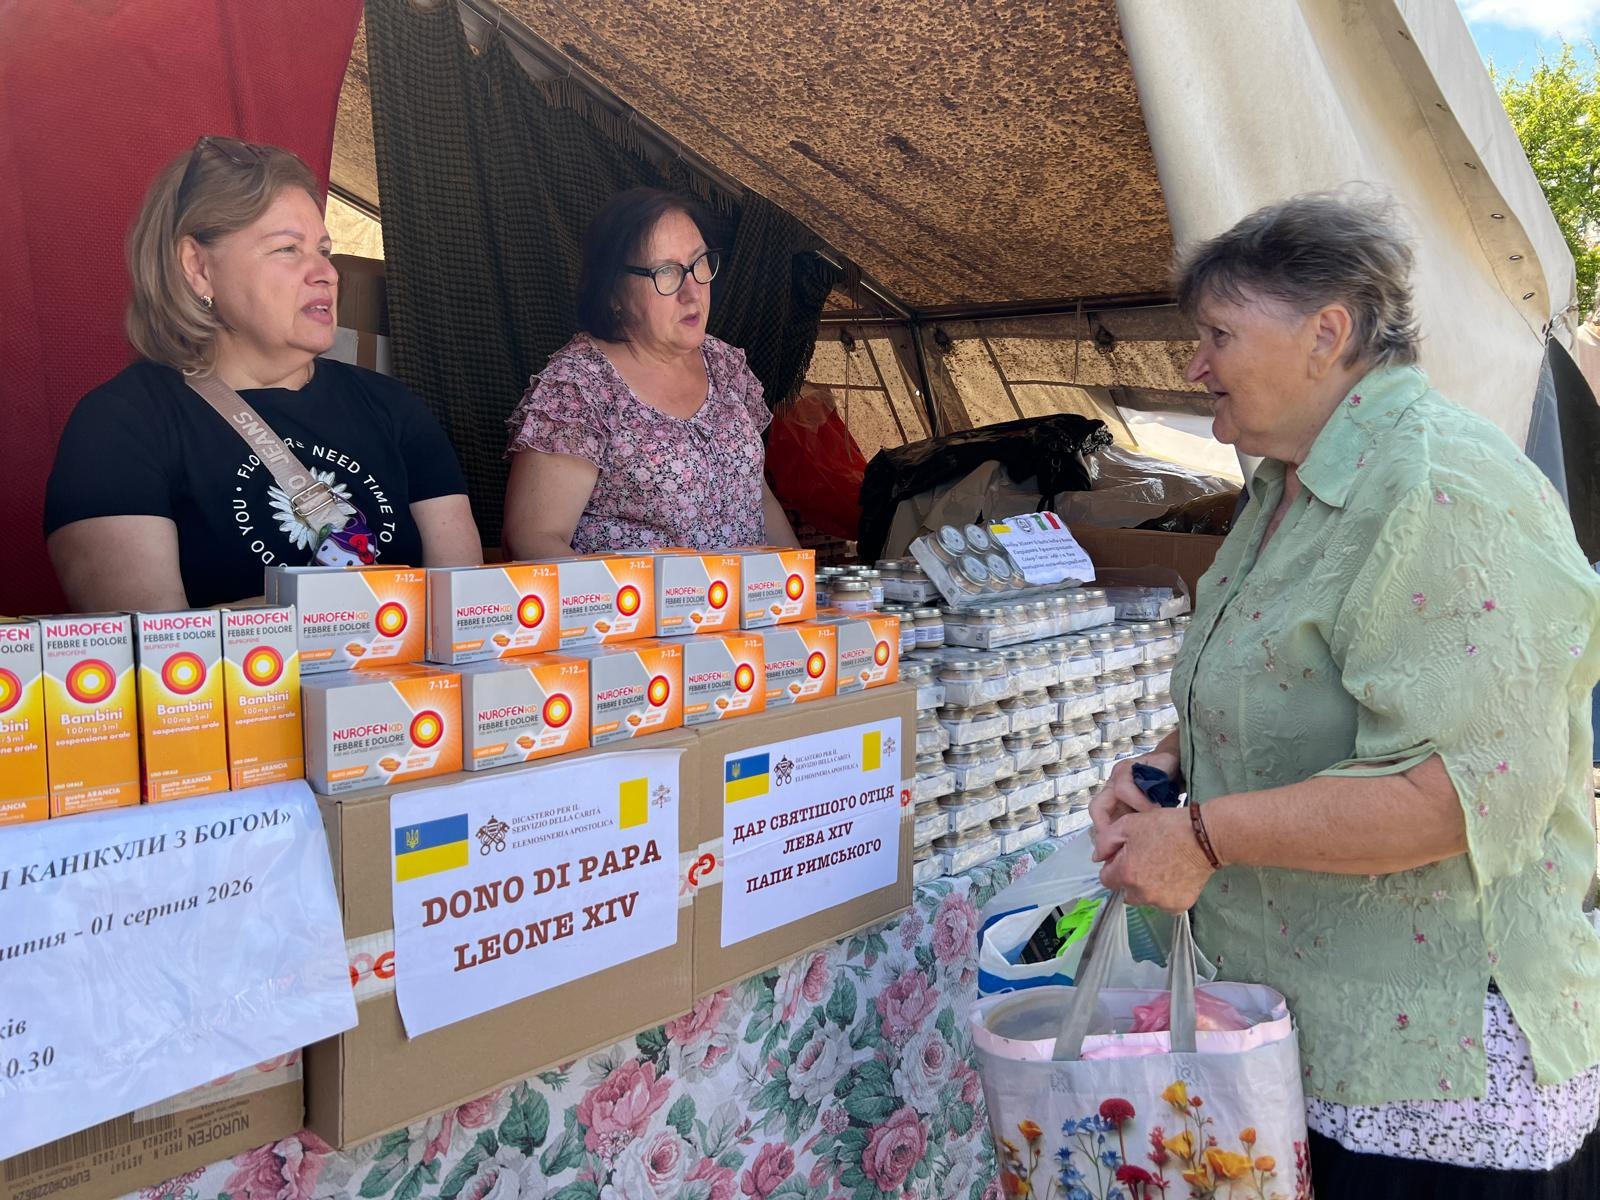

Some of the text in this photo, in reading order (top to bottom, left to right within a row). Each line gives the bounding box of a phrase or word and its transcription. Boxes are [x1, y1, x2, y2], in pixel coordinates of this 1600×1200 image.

[233, 411, 289, 464] JEANS
[312, 445, 361, 475] NEED
[363, 474, 394, 515] TIME
[379, 522, 396, 543] TO
[232, 499, 275, 565] DO YOU
[395, 573, 416, 583] 7-12
[532, 568, 550, 577] 7-12
[561, 594, 600, 606] NUROFEN
[228, 612, 289, 627] NUROFEN
[303, 611, 355, 624] NUROFEN
[456, 605, 500, 617] NUROFEN
[143, 615, 212, 631] NUROFEN
[303, 625, 332, 634] FEBBRE
[340, 622, 371, 632] DOLORE
[457, 617, 480, 627] FEBBRE
[487, 614, 513, 623] DOLORE
[46, 622, 123, 638] NUROFEN
[144, 630, 216, 643] FEBBRE E DOLORE
[228, 628, 254, 637] FEBBRE
[257, 627, 261, 635] E
[262, 625, 293, 634] DOLORE
[47, 635, 127, 650] FEBBRE E DOLORE
[560, 665, 579, 675] 7-12
[767, 670, 781, 678] EBBRE
[429, 680, 450, 690] 7-12
[239, 691, 289, 706] Bambini
[596, 687, 633, 701] NUROFEN
[157, 699, 213, 715] Bambini
[478, 705, 524, 722] NUROFEN
[61, 708, 123, 725] Bambini
[478, 720, 503, 732] FEBBRE
[511, 715, 539, 726] DOLORE
[333, 723, 388, 741] NUROFEN
[333, 740, 363, 752] FEBBRE
[365, 738, 370, 747] E
[371, 733, 405, 746] DOLORE
[512, 803, 580, 825] DICASTERO PER IL
[732, 785, 895, 844] ДАР СВЯТІШОГО ОТЦЯ
[511, 820, 548, 834] SERVIZIO
[549, 815, 574, 825] DELLA
[512, 819, 614, 849] ELEMOSINERIA APOSTOLICA
[783, 821, 854, 854] ЛЕВА XIV
[19, 834, 167, 886] КАНІКУЛИ
[173, 829, 186, 849] З
[195, 808, 292, 844] БОГОМ»
[746, 866, 793, 893] ПАПИ
[796, 838, 882, 877] РИМСЬКОГО
[422, 875, 524, 927] DONO
[533, 862, 571, 895] DI
[578, 839, 662, 883] PAPA
[91, 912, 114, 936] 01
[123, 895, 198, 926] серпня
[206, 876, 254, 904] 2026
[453, 912, 574, 972] LEONE
[582, 891, 639, 931] XIV
[0, 1046, 55, 1079] 0.30
[187, 1114, 250, 1149] NUROFEN
